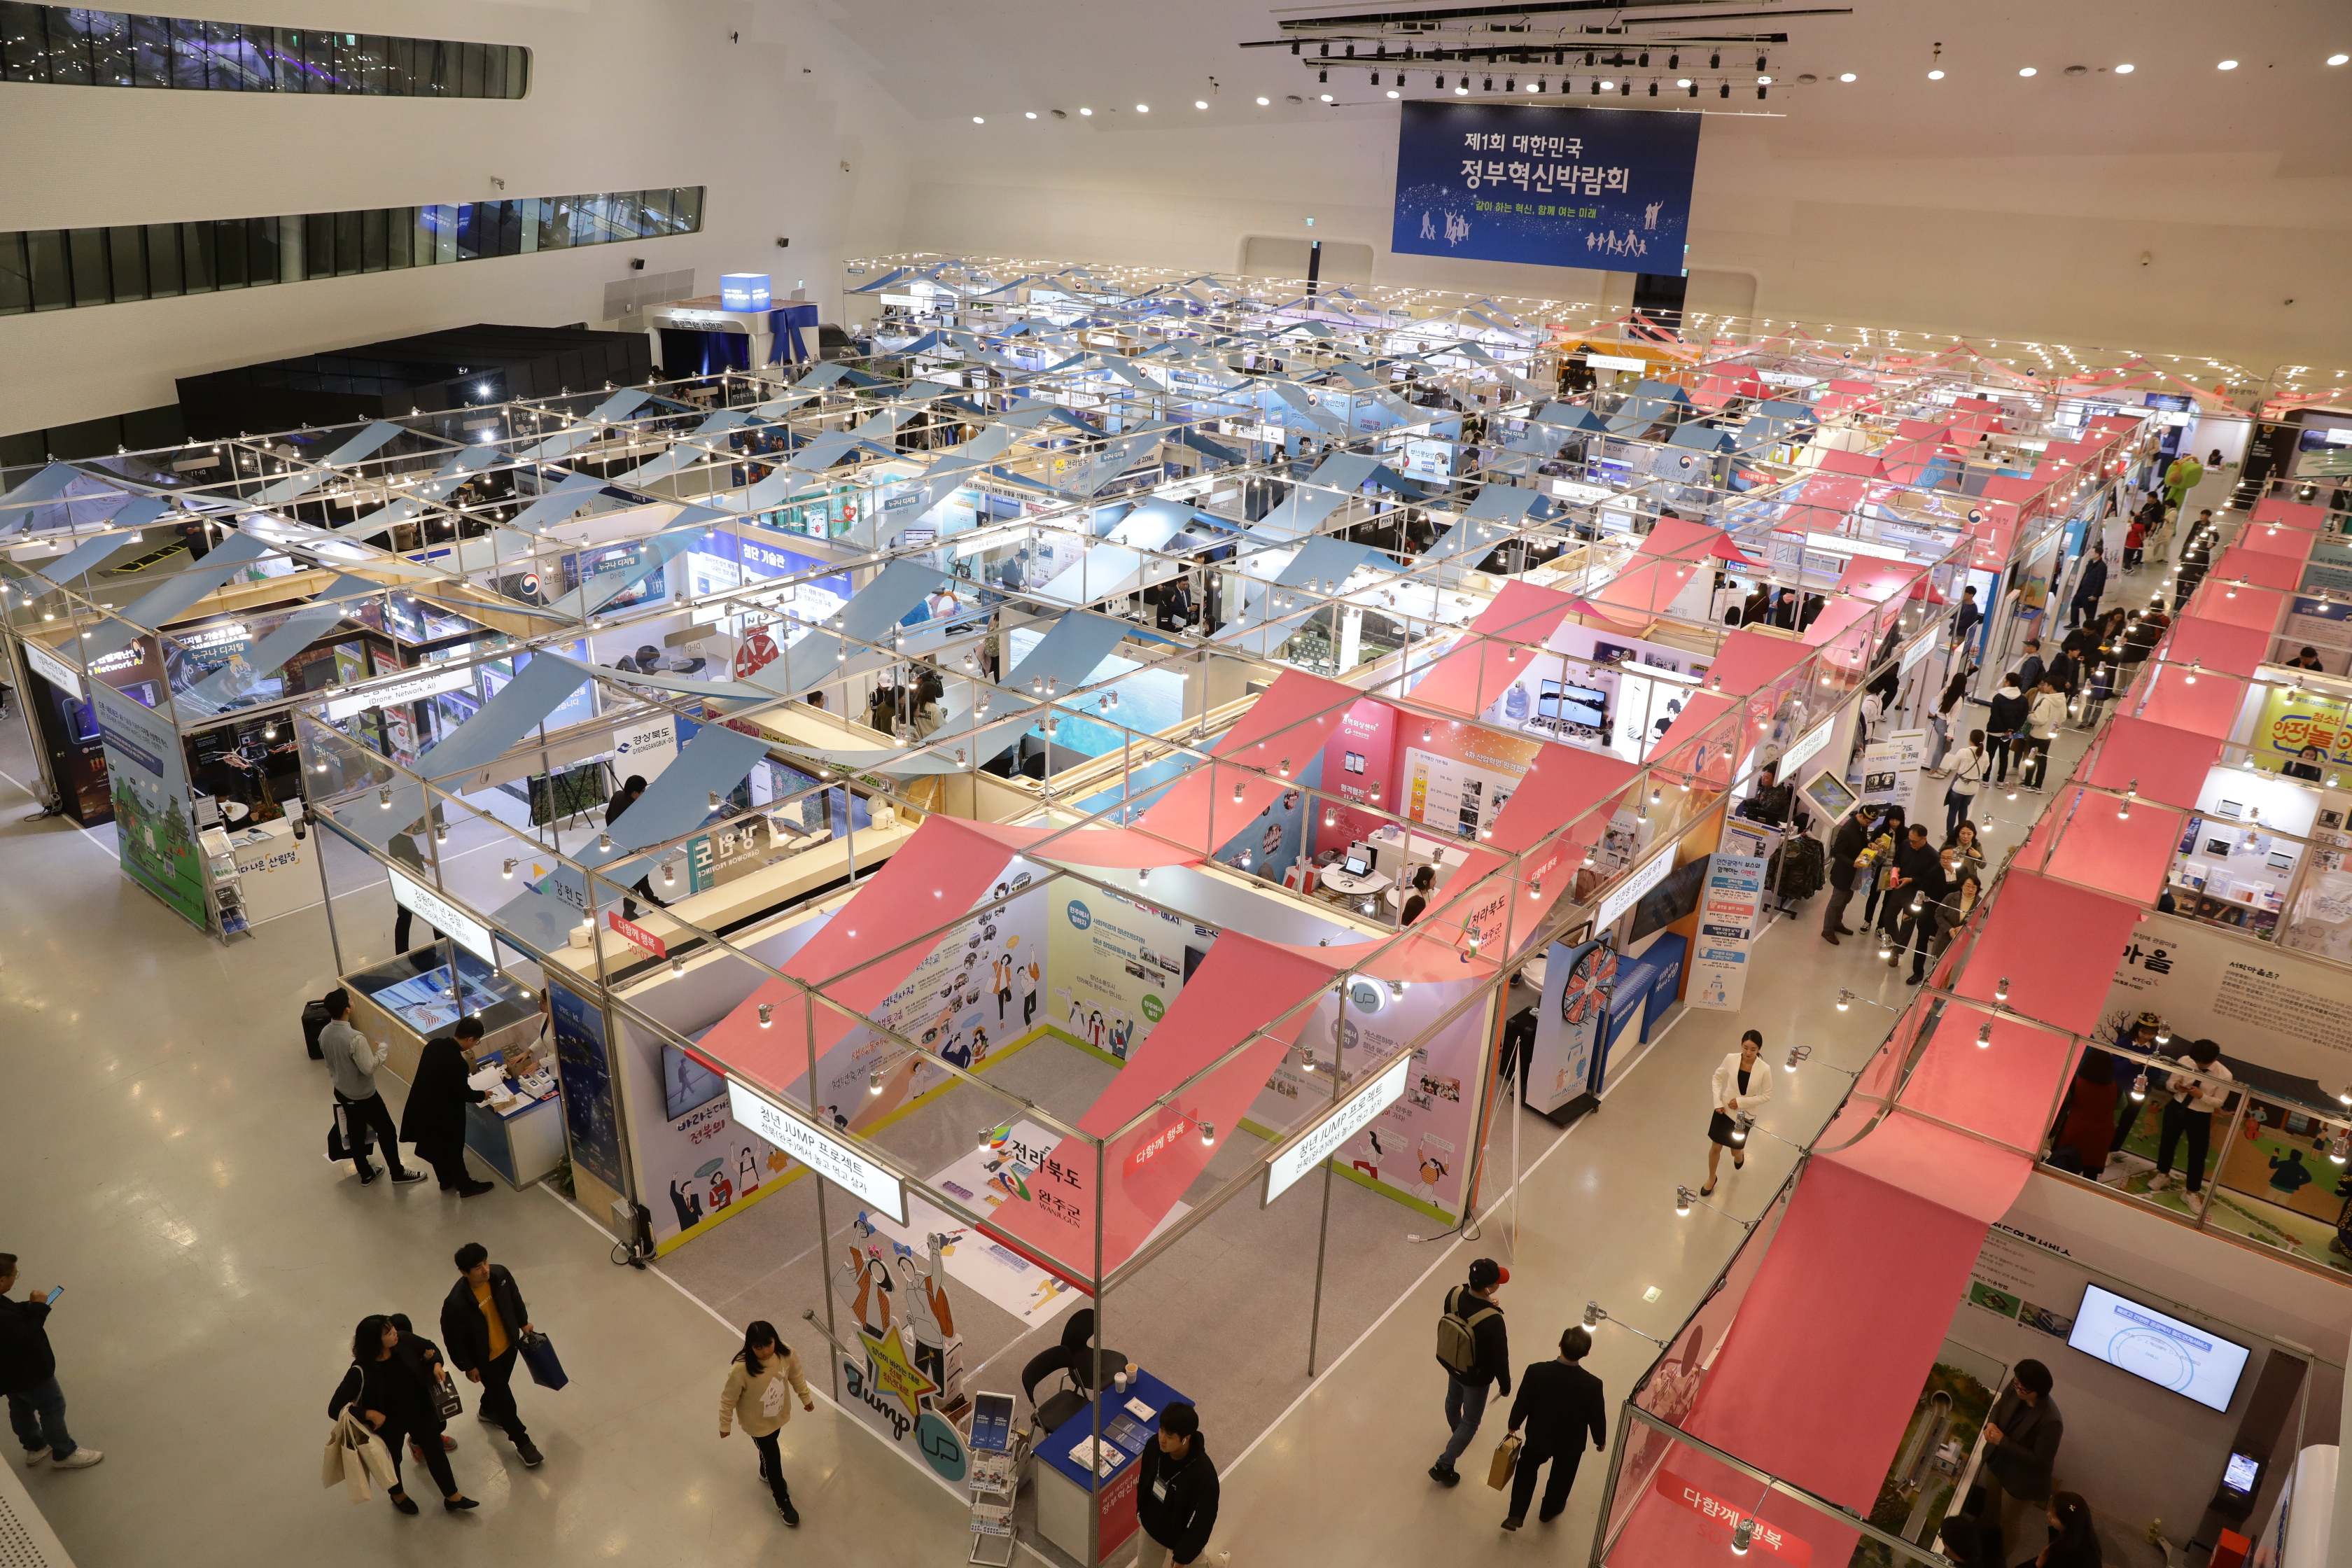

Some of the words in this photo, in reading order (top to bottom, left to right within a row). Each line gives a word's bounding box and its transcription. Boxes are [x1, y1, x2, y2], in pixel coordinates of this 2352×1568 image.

[1464, 133, 1505, 152] 제1회
[1512, 135, 1583, 159] 대한민국
[1460, 160, 1630, 196] 정부혁신박람회
[1476, 201, 1492, 211] 같이
[1496, 202, 1512, 213] 하는
[1516, 203, 1535, 215] 혁신,
[1538, 204, 1555, 216] 함께
[1558, 205, 1576, 218] 여는
[1578, 206, 1597, 218] 미래
[889, 499, 902, 507] 누구나
[598, 561, 616, 571] 누구나
[618, 556, 635, 567] 디지털
[743, 543, 759, 561] 첨단
[761, 550, 785, 568] 기술관
[610, 570, 626, 580] DI-08
[192, 647, 217, 661] 누구나
[220, 642, 245, 654] 디지털
[94, 662, 132, 675] Network
[369, 693, 393, 706] (Drone,
[396, 686, 425, 699] Network,
[632, 736, 674, 755] GYEONGSANGBUK-DO
[633, 727, 670, 746] 경상북도
[312, 743, 326, 757] 누구나
[1465, 750, 1476, 759] 4차
[1340, 783, 1364, 799] 원격협진
[250, 860, 265, 872] 나은
[269, 850, 296, 868] 산림청
[1548, 855, 1558, 870] 행복
[1716, 858, 1743, 867] 인천광역시
[554, 879, 584, 906] 강원도
[414, 889, 437, 910] 강원아!
[439, 903, 446, 915] 넌
[447, 909, 464, 928] 정말!
[1070, 906, 1089, 920] 완주에서
[1471, 895, 1506, 926] 전라북도
[439, 915, 454, 932] 안전한
[1072, 915, 1086, 927] 일하자
[1093, 918, 1116, 932] 사회적경제
[618, 919, 639, 941] 다함께
[640, 932, 656, 949] 행복
[1093, 937, 1102, 946] 청년
[1480, 922, 1503, 944] 완주군
[627, 942, 649, 962] SO-07
[2229, 961, 2280, 979] 서악마을은?
[881, 983, 916, 1008] 청년사장
[1144, 1000, 1163, 1014] 완주에서
[1363, 1042, 1375, 1052] 청년
[1364, 1029, 1399, 1049] 게스트하우스
[832, 1065, 867, 1091] 청년축제
[1392, 1112, 1406, 1123] 가자!
[1395, 1104, 1413, 1117] 완주로
[1299, 1134, 1317, 1158] 청년
[1320, 1113, 1347, 1144] JUMP
[1348, 1083, 1383, 1118] 프로젝트
[690, 1120, 725, 1144] 전북의
[760, 1105, 780, 1129] 청년
[785, 1122, 816, 1147] JUMP
[819, 1141, 864, 1177] 프로젝트
[1296, 1133, 1340, 1175] 전북(완주)에서
[1341, 1121, 1354, 1137] 놀고
[1357, 1110, 1368, 1124] 먹고
[1370, 1098, 1382, 1115] 살자
[1136, 1137, 1165, 1164] 다함께
[1167, 1121, 1185, 1143] 행복
[760, 1122, 812, 1161] 전북(완주)에서
[814, 1155, 830, 1170] 놀고
[832, 1164, 848, 1182] 먹고
[851, 1175, 867, 1194] 살자
[1011, 1139, 1082, 1189] 전라북도
[1038, 1189, 1081, 1222] 완주군
[1039, 1203, 1081, 1229] WANJUGUN
[872, 1346, 888, 1364] 청년이
[890, 1359, 906, 1376] 바라는
[908, 1373, 920, 1386] 대로
[889, 1367, 902, 1383] 전북
[883, 1372, 910, 1397] 청년대로
[1102, 1491, 1114, 1503] 제1회
[1115, 1474, 1133, 1492] 대한민국
[1684, 1488, 1741, 1528] 다함께
